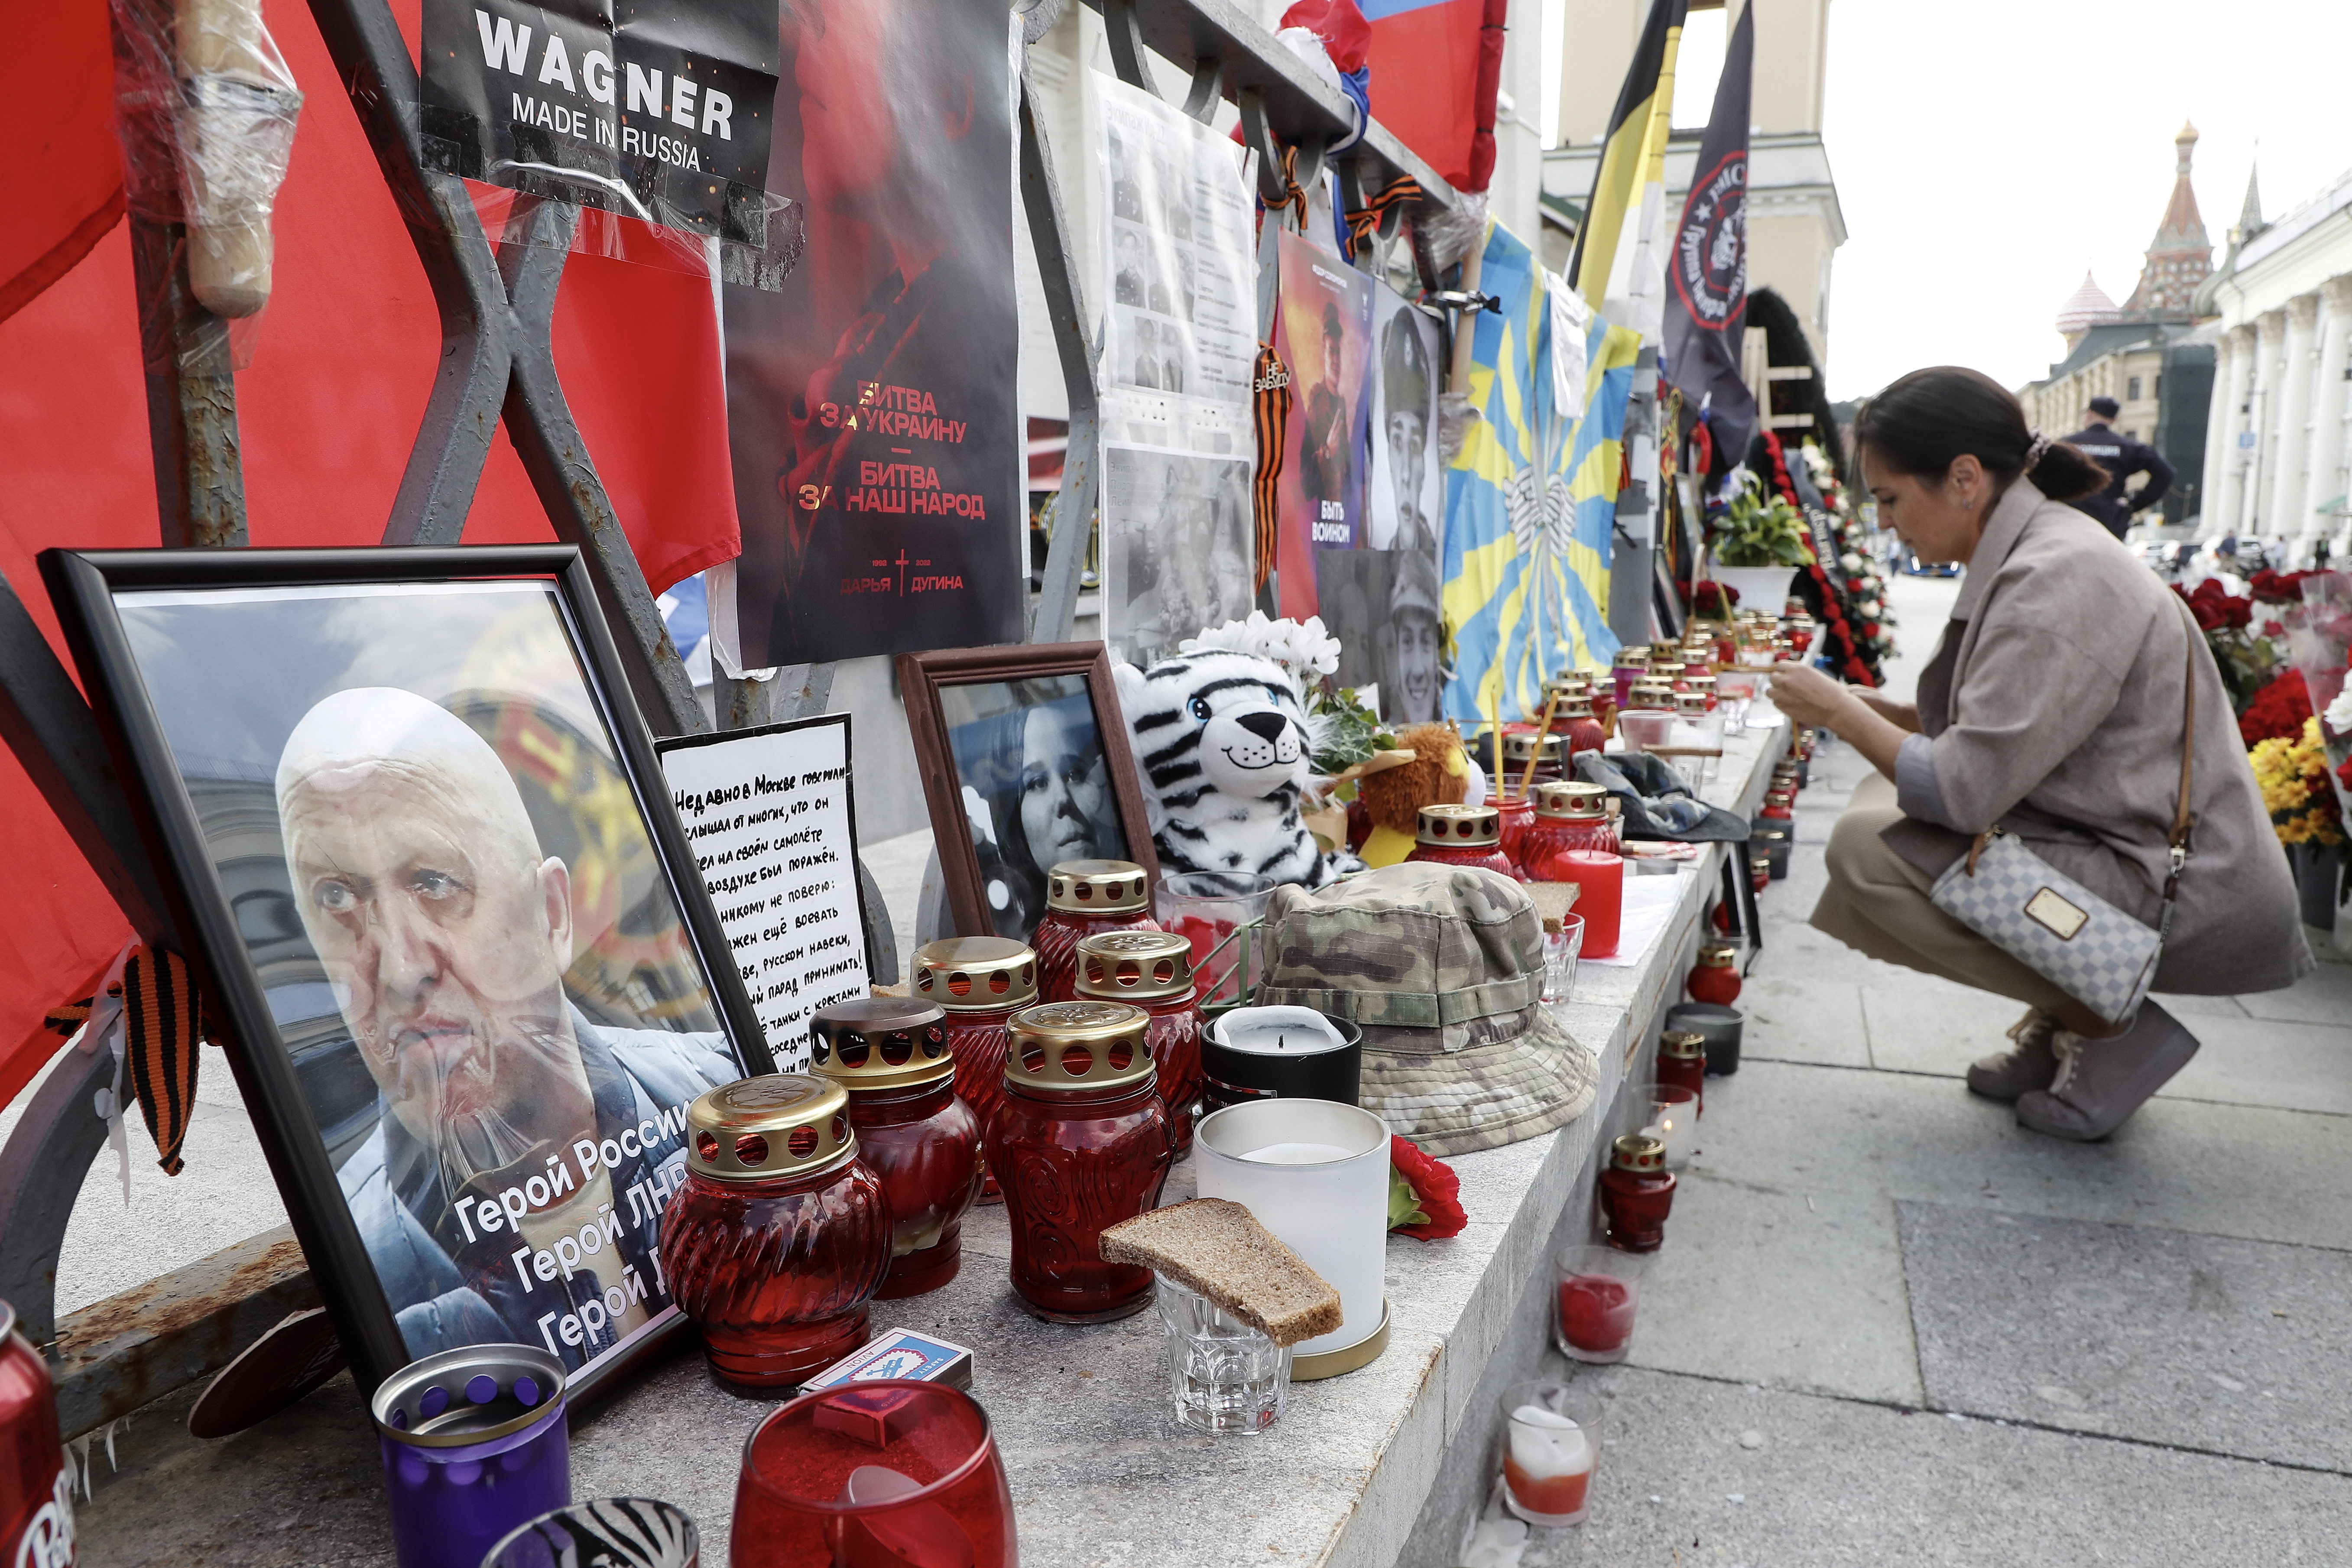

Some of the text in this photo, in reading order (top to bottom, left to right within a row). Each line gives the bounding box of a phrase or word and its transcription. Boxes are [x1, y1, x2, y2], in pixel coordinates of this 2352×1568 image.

[474, 9, 733, 141] WAGNER
[512, 92, 701, 172] MADE IN RUSSIA
[1255, 373, 1290, 393] ЗАБУДУ
[1266, 362, 1278, 375] НЕ
[857, 380, 937, 415] БИТВА
[820, 403, 966, 443] ЗА УКРАИНУ
[861, 461, 940, 490] БИТВА
[798, 484, 985, 520] ЗА НАШ НАРОД
[1321, 500, 1344, 521] БЫТЬ
[1312, 521, 1350, 543] ВОИНОМ
[840, 576, 963, 595] ДАРЬЯ ДУГИНА
[675, 766, 845, 818] Недавно в Москве говорили
[734, 815, 744, 830] от
[748, 806, 789, 828] многих,
[791, 801, 808, 815] что
[815, 797, 829, 809] он
[696, 826, 823, 871] ел на своём самолёте
[707, 846, 839, 894] воздухе был поражён.
[720, 880, 835, 923] никому не поверю:
[763, 917, 787, 941] ещё
[795, 907, 838, 929] воевать
[810, 934, 850, 956] навеки,
[768, 978, 798, 1000] парад
[804, 948, 862, 986] принимать!
[770, 1010, 800, 1030] танки
[804, 1006, 811, 1016] с
[815, 986, 860, 1012] крестами
[770, 1032, 810, 1056] соседне
[454, 1100, 689, 1244] Герой России
[511, 1202, 625, 1294] Герой
[536, 1264, 648, 1357] Герой
[846, 1350, 877, 1369] AVION
[919, 1357, 944, 1375] SAFETY
